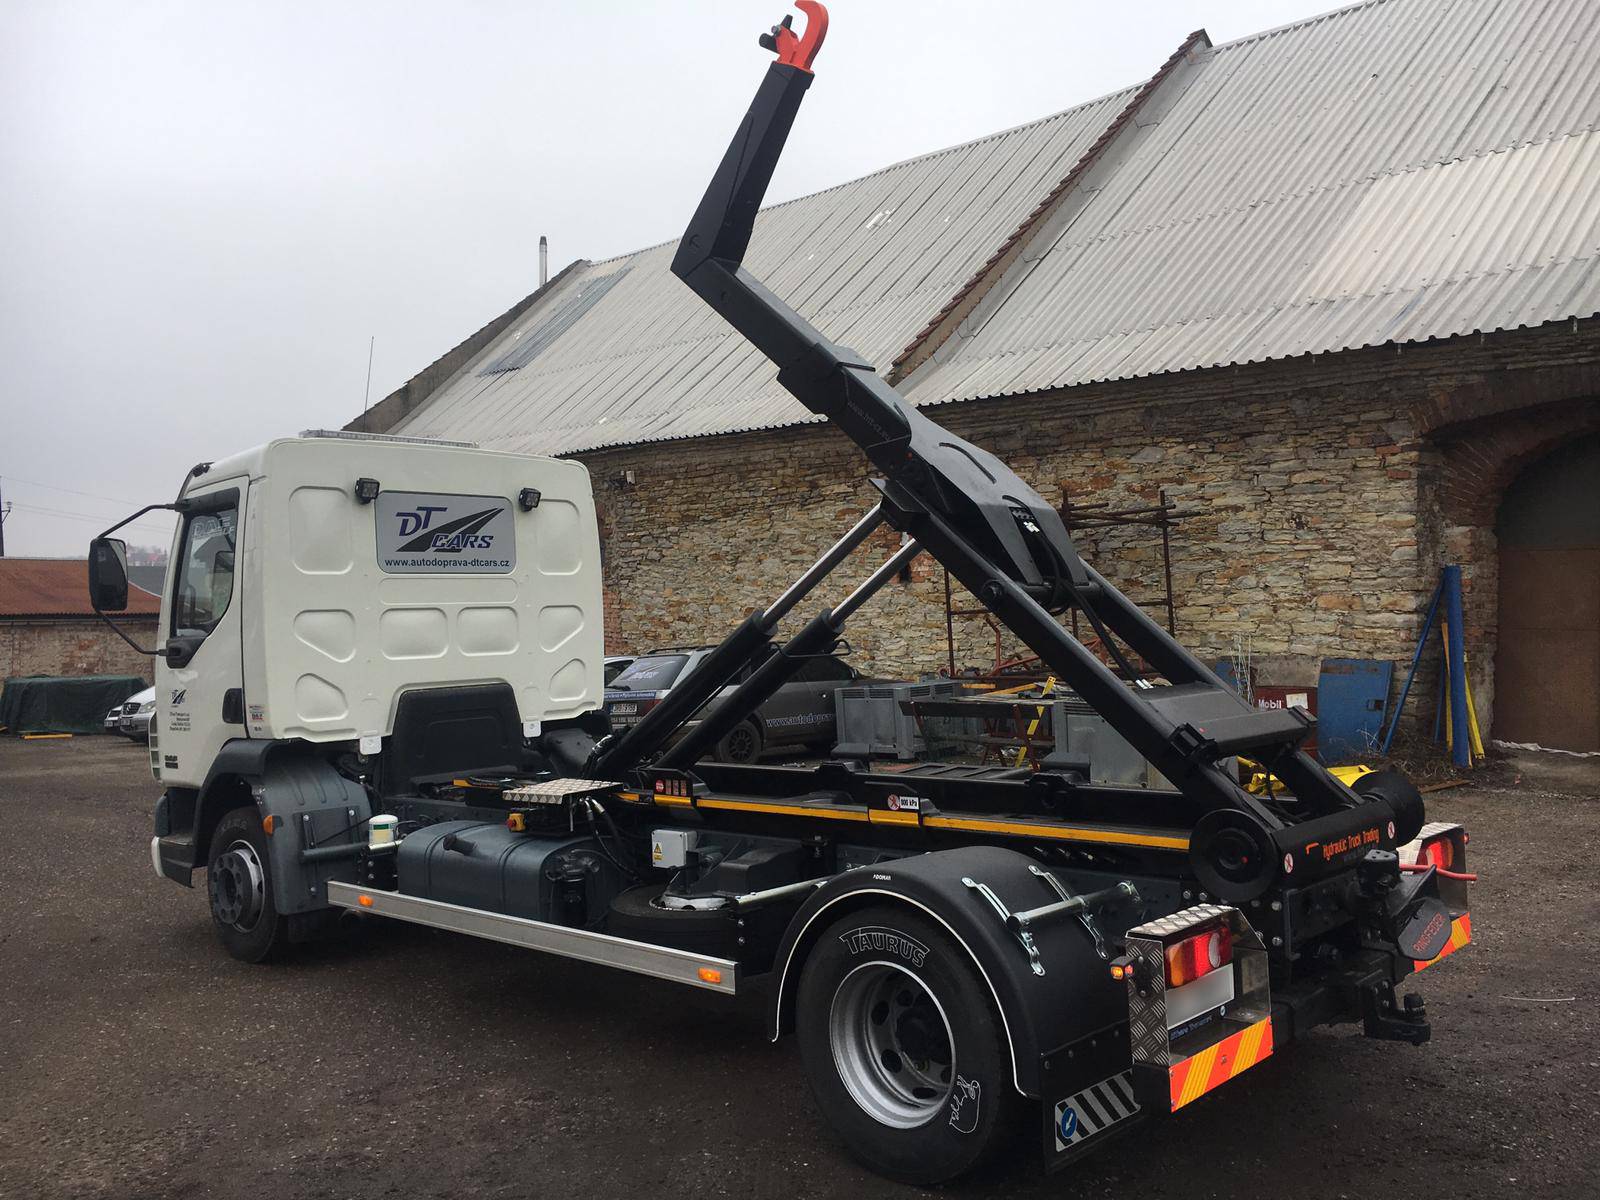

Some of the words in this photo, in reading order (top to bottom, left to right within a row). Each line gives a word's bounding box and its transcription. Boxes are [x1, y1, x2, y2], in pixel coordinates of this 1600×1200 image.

[395, 506, 448, 537] DT
[431, 533, 494, 550] CARS
[384, 557, 510, 569] www.autodoprava-dtcars.cz
[1258, 699, 1282, 709] Mobil
[839, 926, 931, 967] TAURUS
